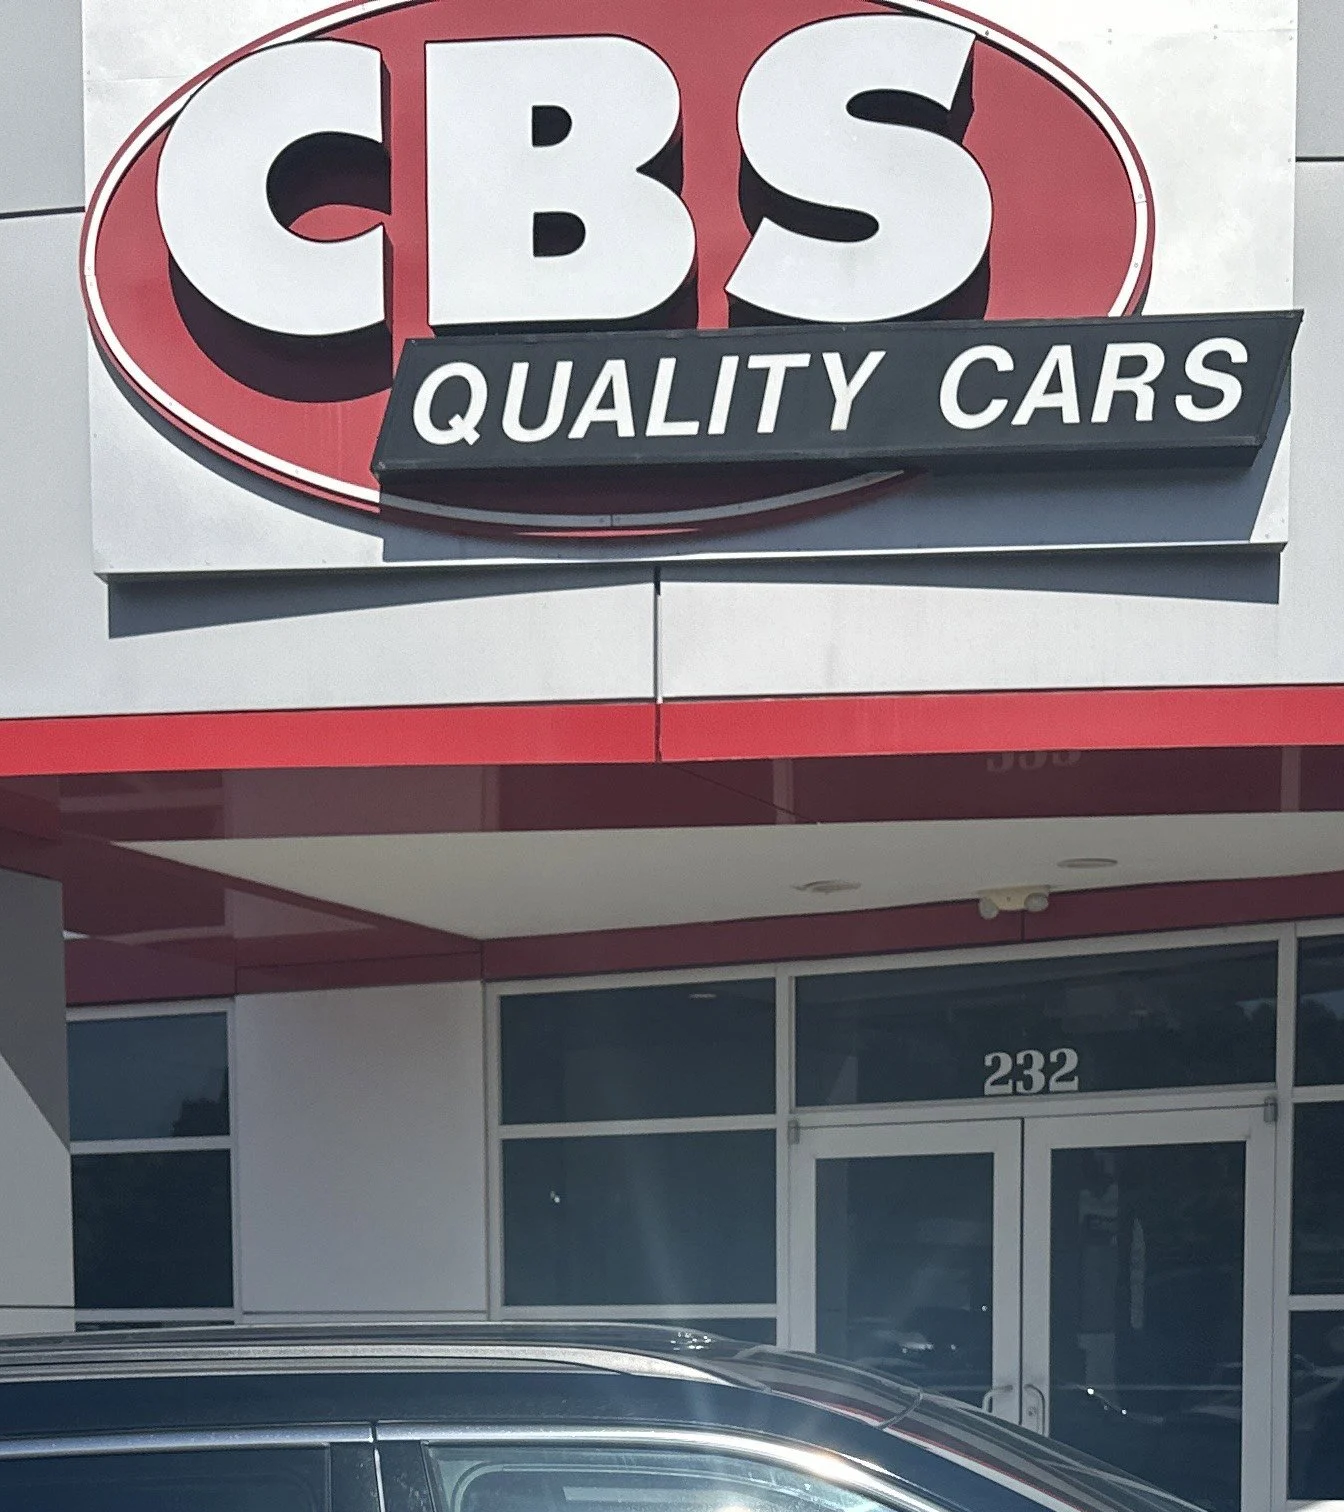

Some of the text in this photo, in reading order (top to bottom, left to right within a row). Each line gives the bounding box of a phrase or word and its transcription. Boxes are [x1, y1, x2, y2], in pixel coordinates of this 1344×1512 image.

[157, 15, 993, 336] CBS
[413, 337, 1248, 445] QUALITY CARS
[984, 1048, 1079, 1095] 232
